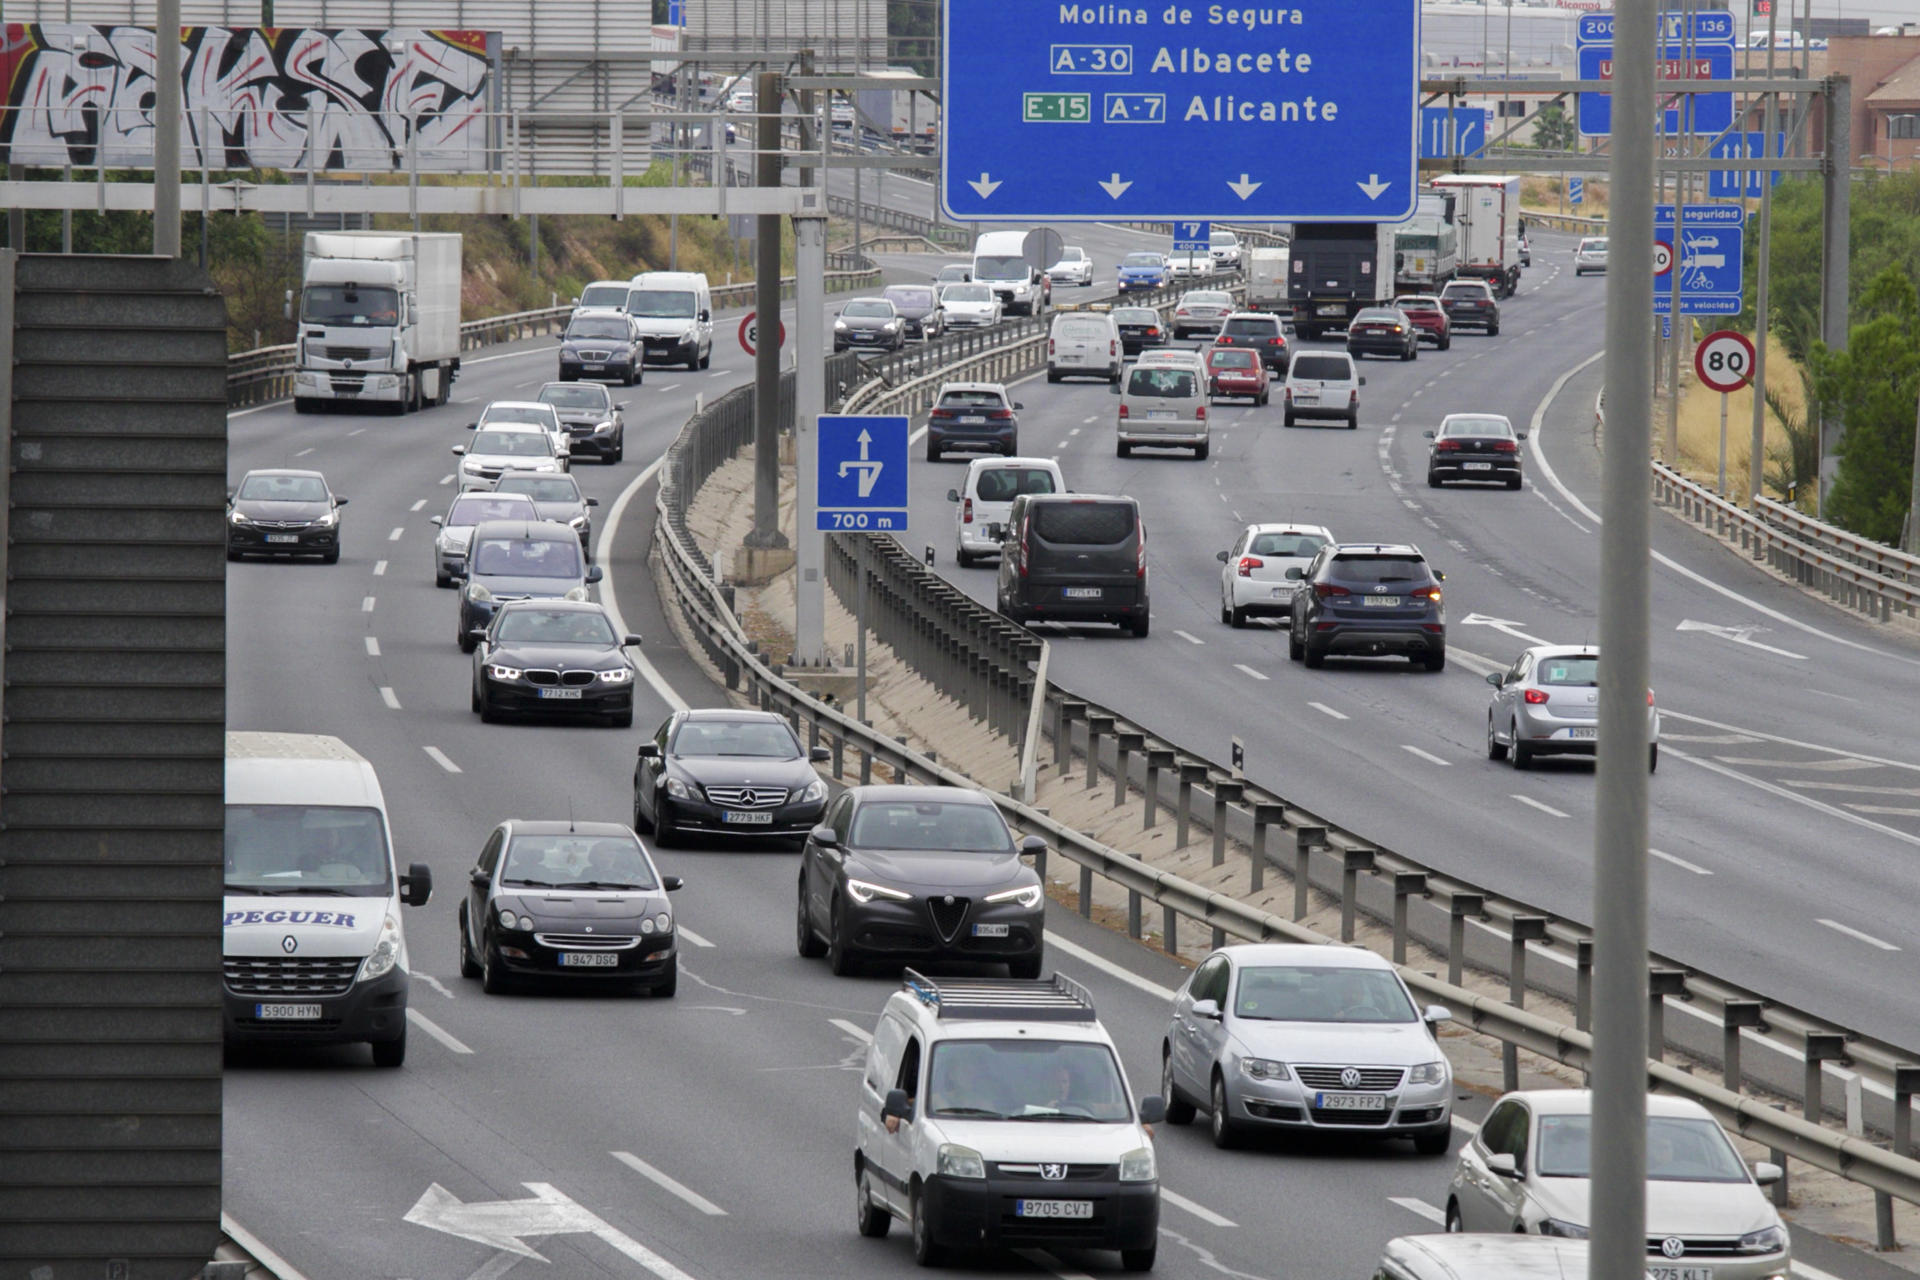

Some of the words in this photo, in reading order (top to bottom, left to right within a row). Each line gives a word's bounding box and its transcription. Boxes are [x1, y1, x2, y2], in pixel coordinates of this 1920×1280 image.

[1060, 4, 1148, 25] Molina
[1163, 4, 1193, 25] de
[1208, 4, 1303, 31] Segura
[1702, 20, 1726, 32] 136
[1056, 49, 1129, 71] A-30
[1151, 47, 1313, 74] Albacete
[1026, 98, 1087, 119] E-15
[1109, 98, 1162, 119] A-7
[1184, 95, 1339, 122] Alicante
[1685, 208, 1738, 221] seguridad
[1694, 301, 1735, 309] velocidad
[1708, 351, 1744, 372] 80
[832, 513, 869, 528] 700
[877, 517, 893, 528] m
[565, 954, 593, 966] 1947
[595, 954, 617, 966] DSC
[263, 1005, 295, 1017] 5900
[297, 1005, 320, 1017] HYN
[1325, 1095, 1356, 1108] 2973
[1358, 1096, 1383, 1109] FPZ
[1022, 1202, 1060, 1216] 9705
[1064, 1202, 1092, 1216] CVT
[1684, 1269, 1710, 1280] KLT
